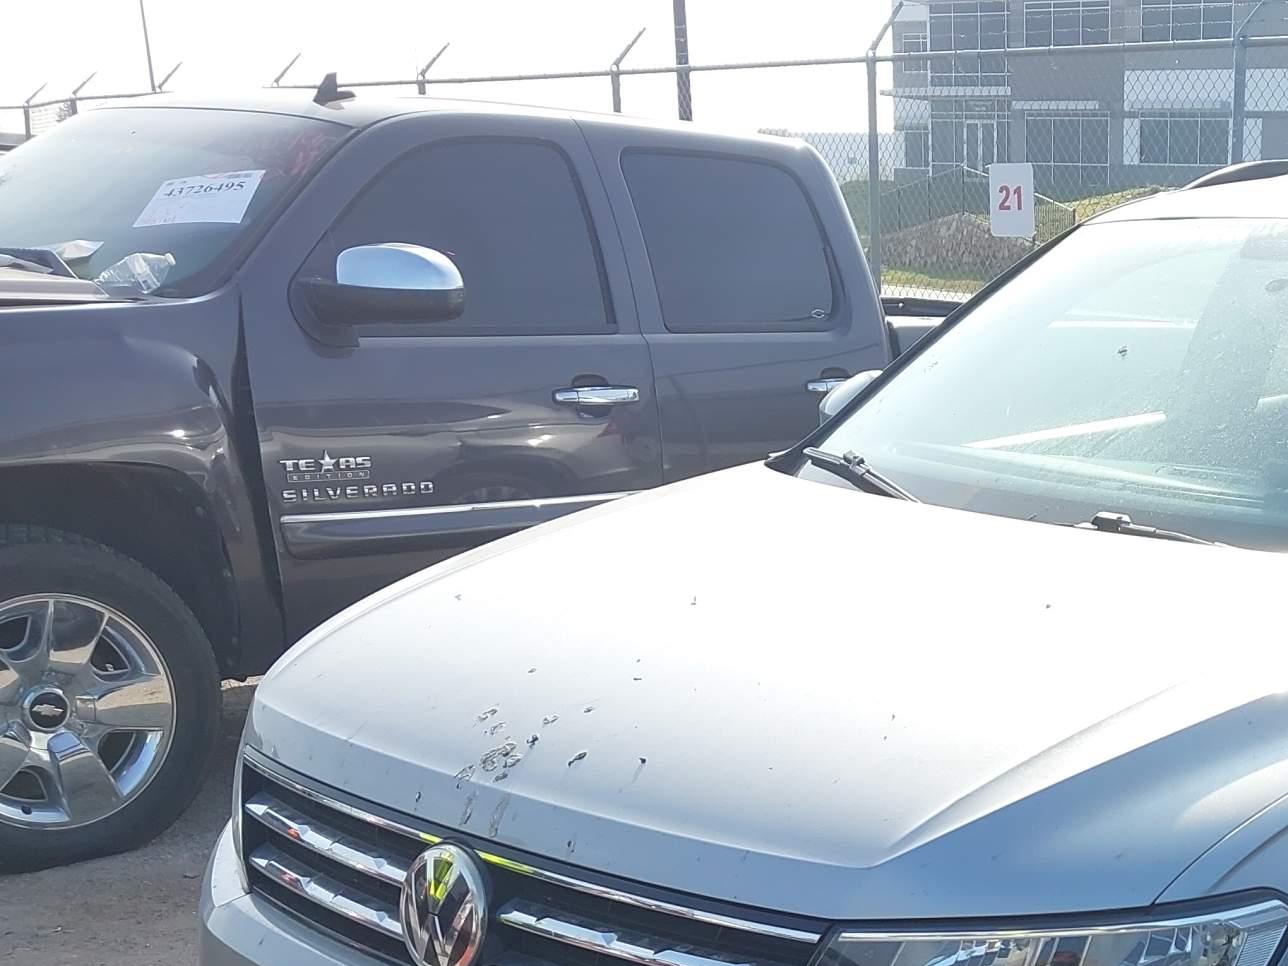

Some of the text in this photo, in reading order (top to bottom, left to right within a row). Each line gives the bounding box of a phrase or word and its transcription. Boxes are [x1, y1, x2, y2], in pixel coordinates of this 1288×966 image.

[163, 180, 247, 198] 43726495
[998, 184, 1023, 211] 21
[291, 471, 367, 482] EDITION
[281, 481, 434, 503] SILVERADO
